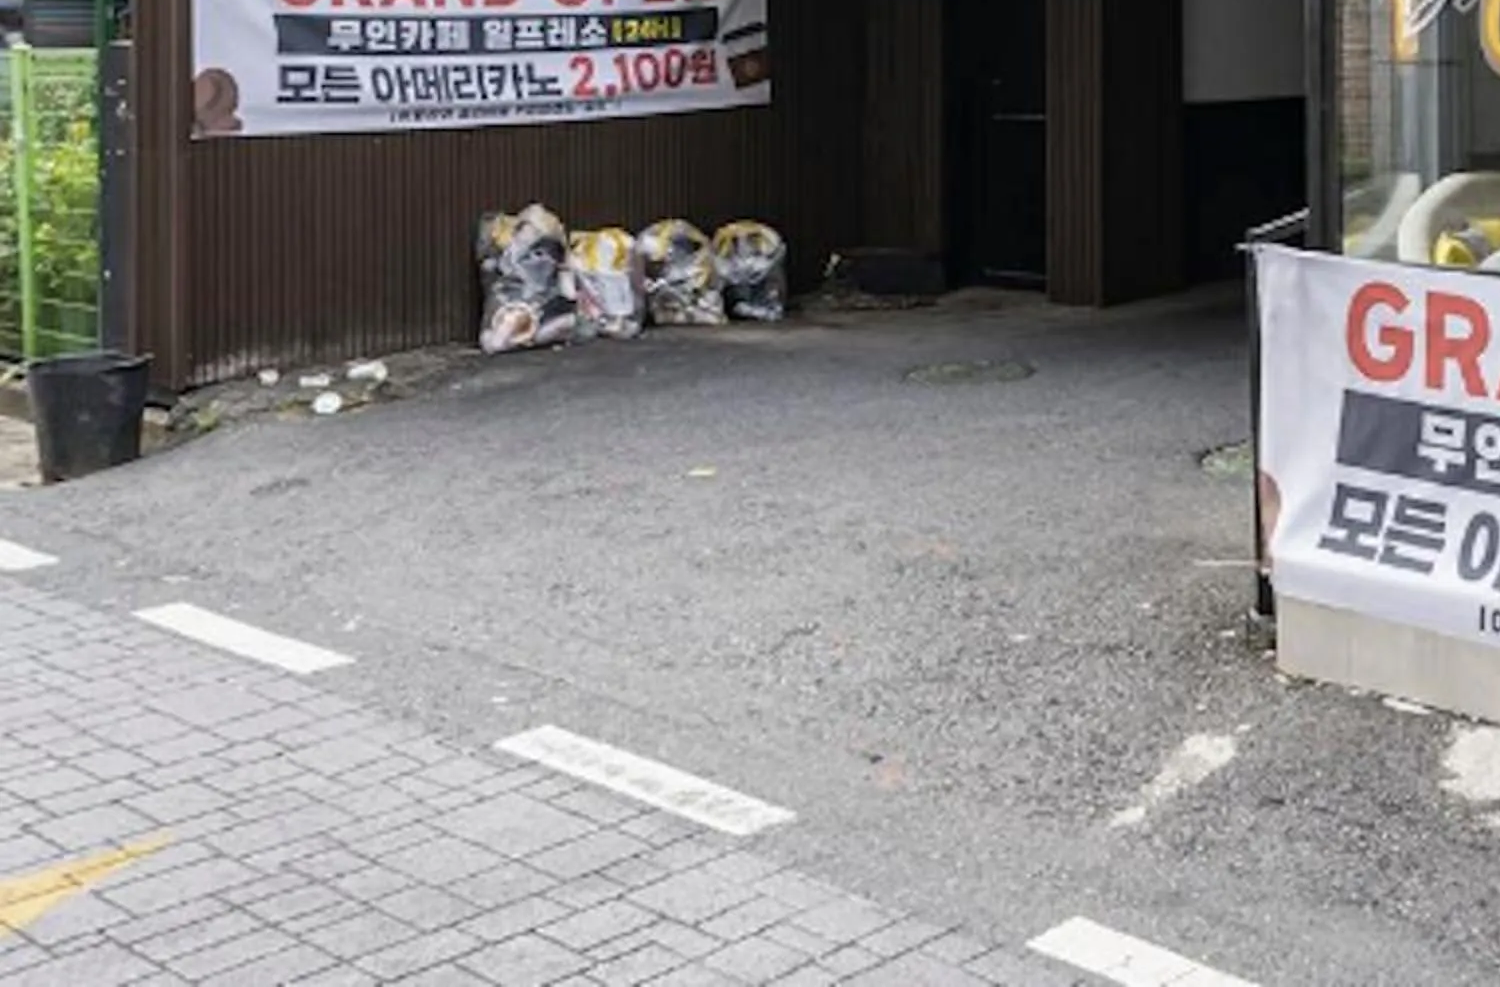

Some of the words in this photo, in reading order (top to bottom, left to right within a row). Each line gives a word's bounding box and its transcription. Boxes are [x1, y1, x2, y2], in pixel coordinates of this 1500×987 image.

[326, 18, 471, 52] 무인카페
[483, 15, 608, 51] 일프레소
[275, 64, 363, 104] 모든
[370, 61, 563, 104] 아메리카노
[1317, 481, 1447, 576] 모든
